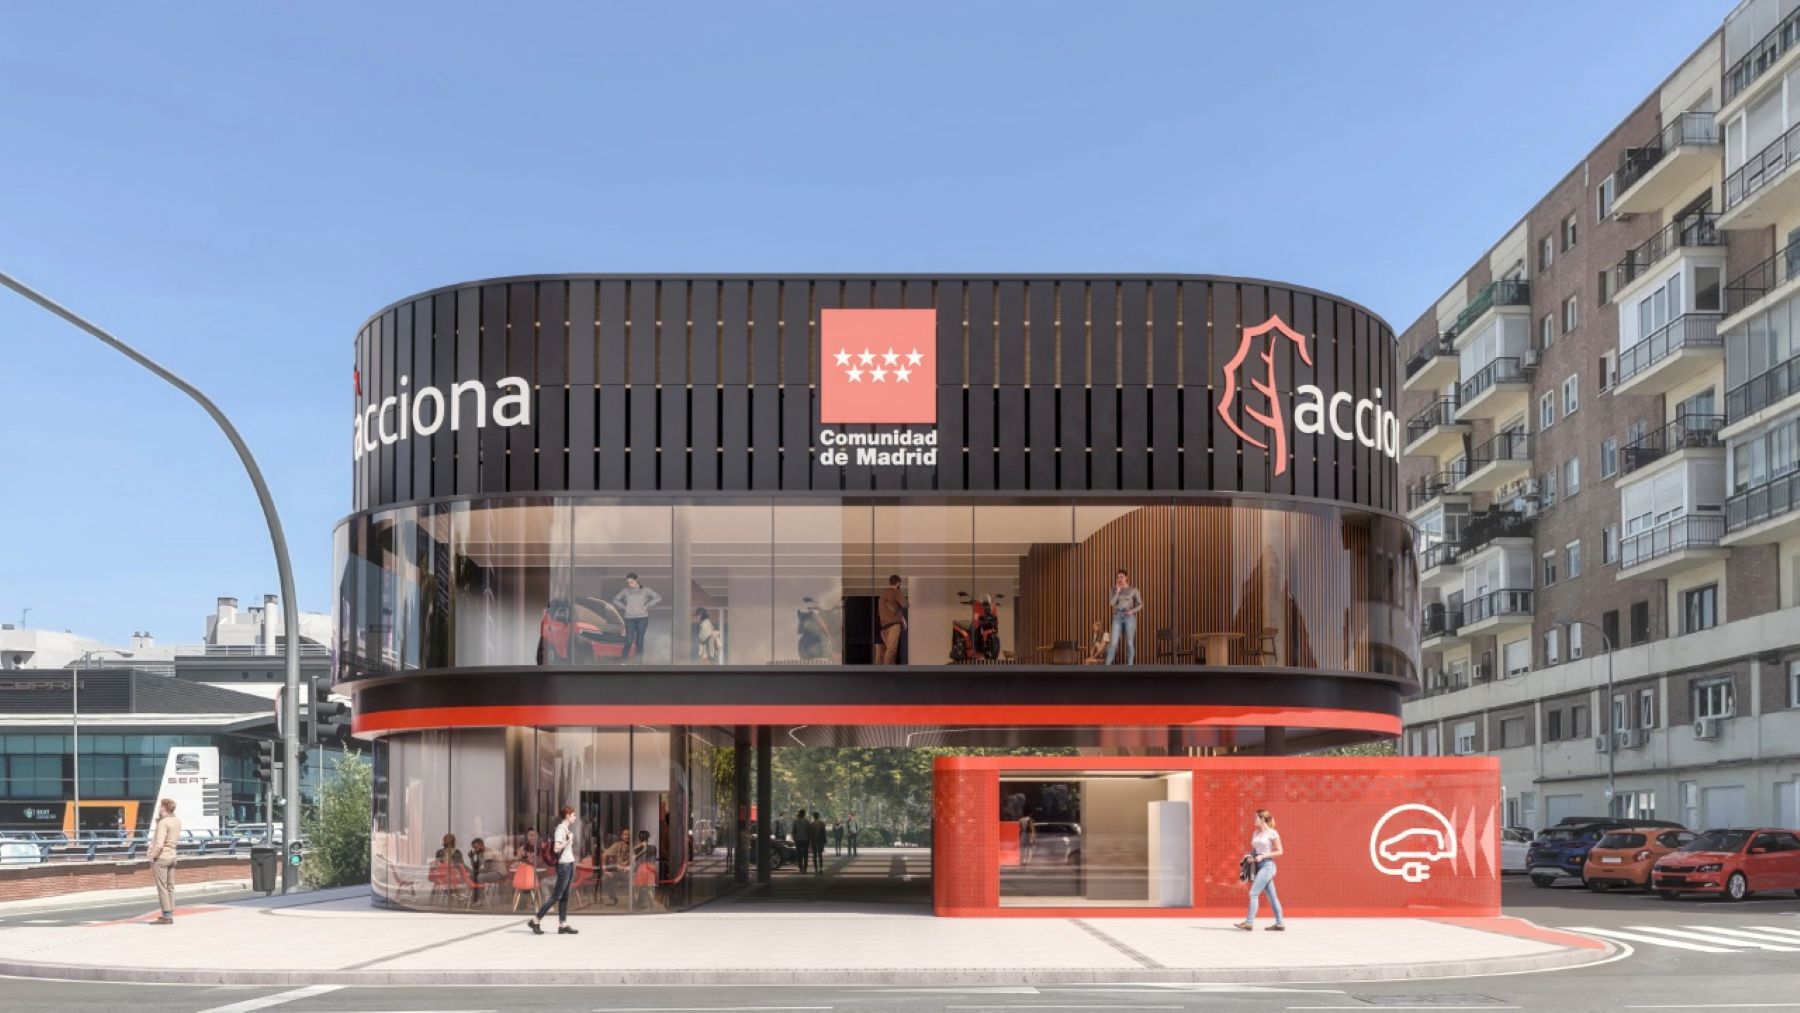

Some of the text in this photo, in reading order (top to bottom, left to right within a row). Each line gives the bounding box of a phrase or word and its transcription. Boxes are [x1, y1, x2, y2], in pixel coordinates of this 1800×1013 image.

[354, 375, 531, 461] acciona
[820, 429, 937, 446] Comunidad
[1294, 384, 1400, 464] accio
[820, 447, 938, 466] de Madrid
